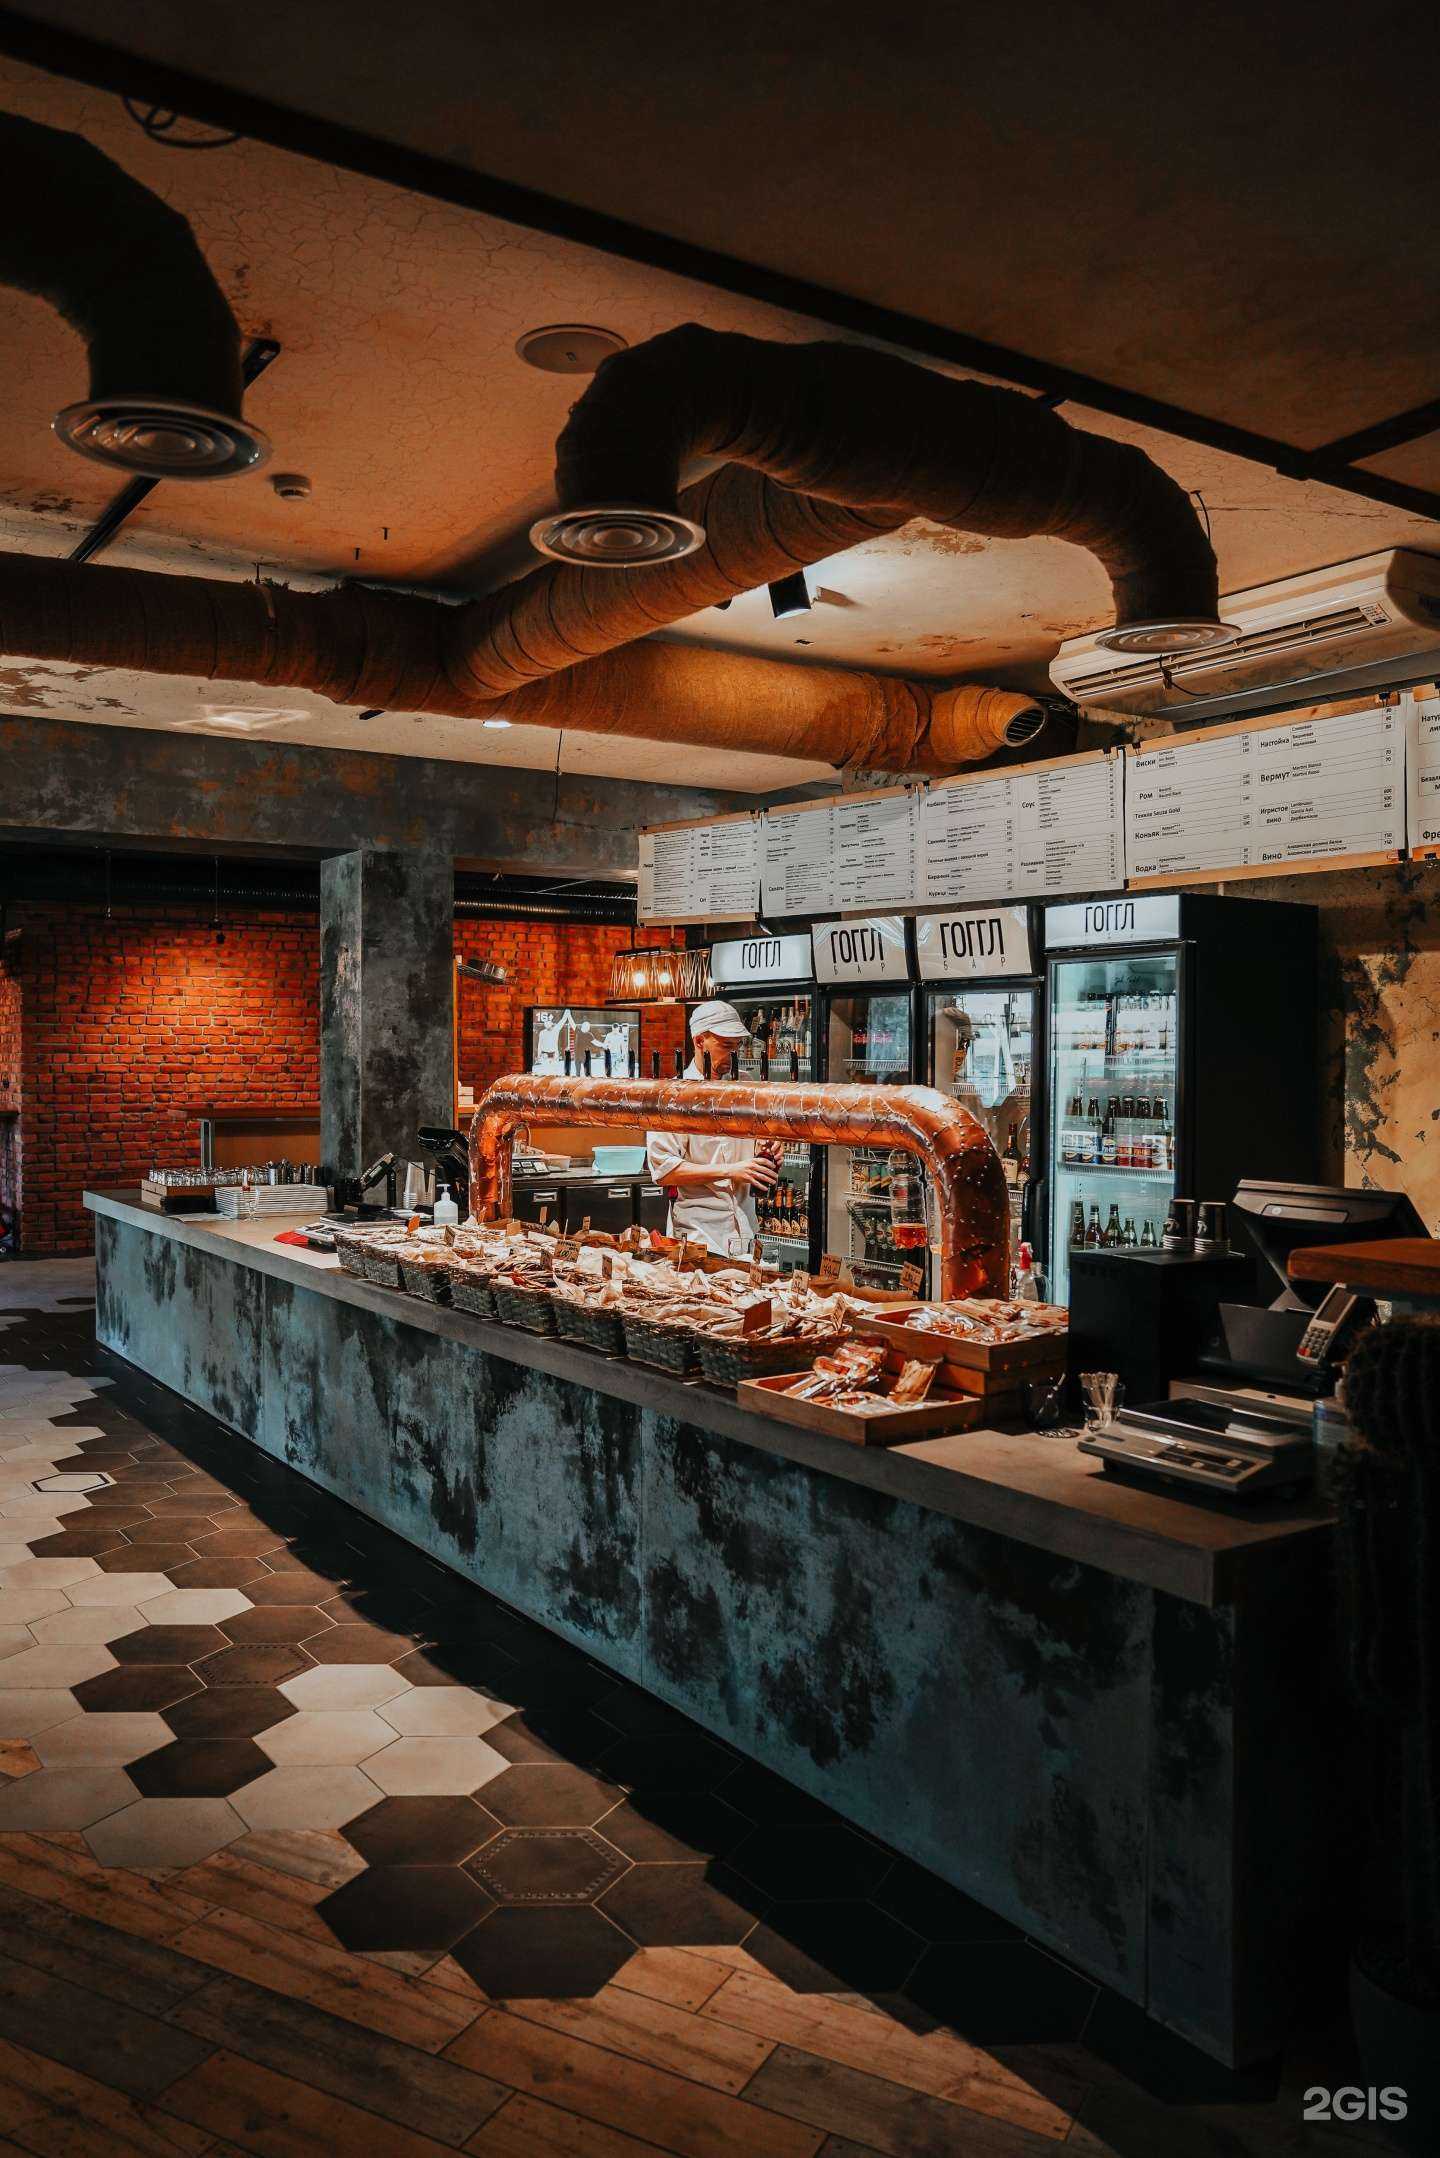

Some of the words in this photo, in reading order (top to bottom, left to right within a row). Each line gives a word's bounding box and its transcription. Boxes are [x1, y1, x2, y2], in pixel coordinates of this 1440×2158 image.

[1135, 759, 1156, 768] Виски
[1260, 771, 1290, 782] Вермут
[1139, 792, 1153, 800] Ром
[1134, 830, 1160, 840] Коньяк
[1262, 852, 1283, 861] Вино
[1135, 863, 1157, 873] Водка
[1085, 902, 1135, 933] ГОГГЛ
[939, 918, 1005, 958] ГОГГЛ
[742, 940, 781, 969] ГОГГЛ
